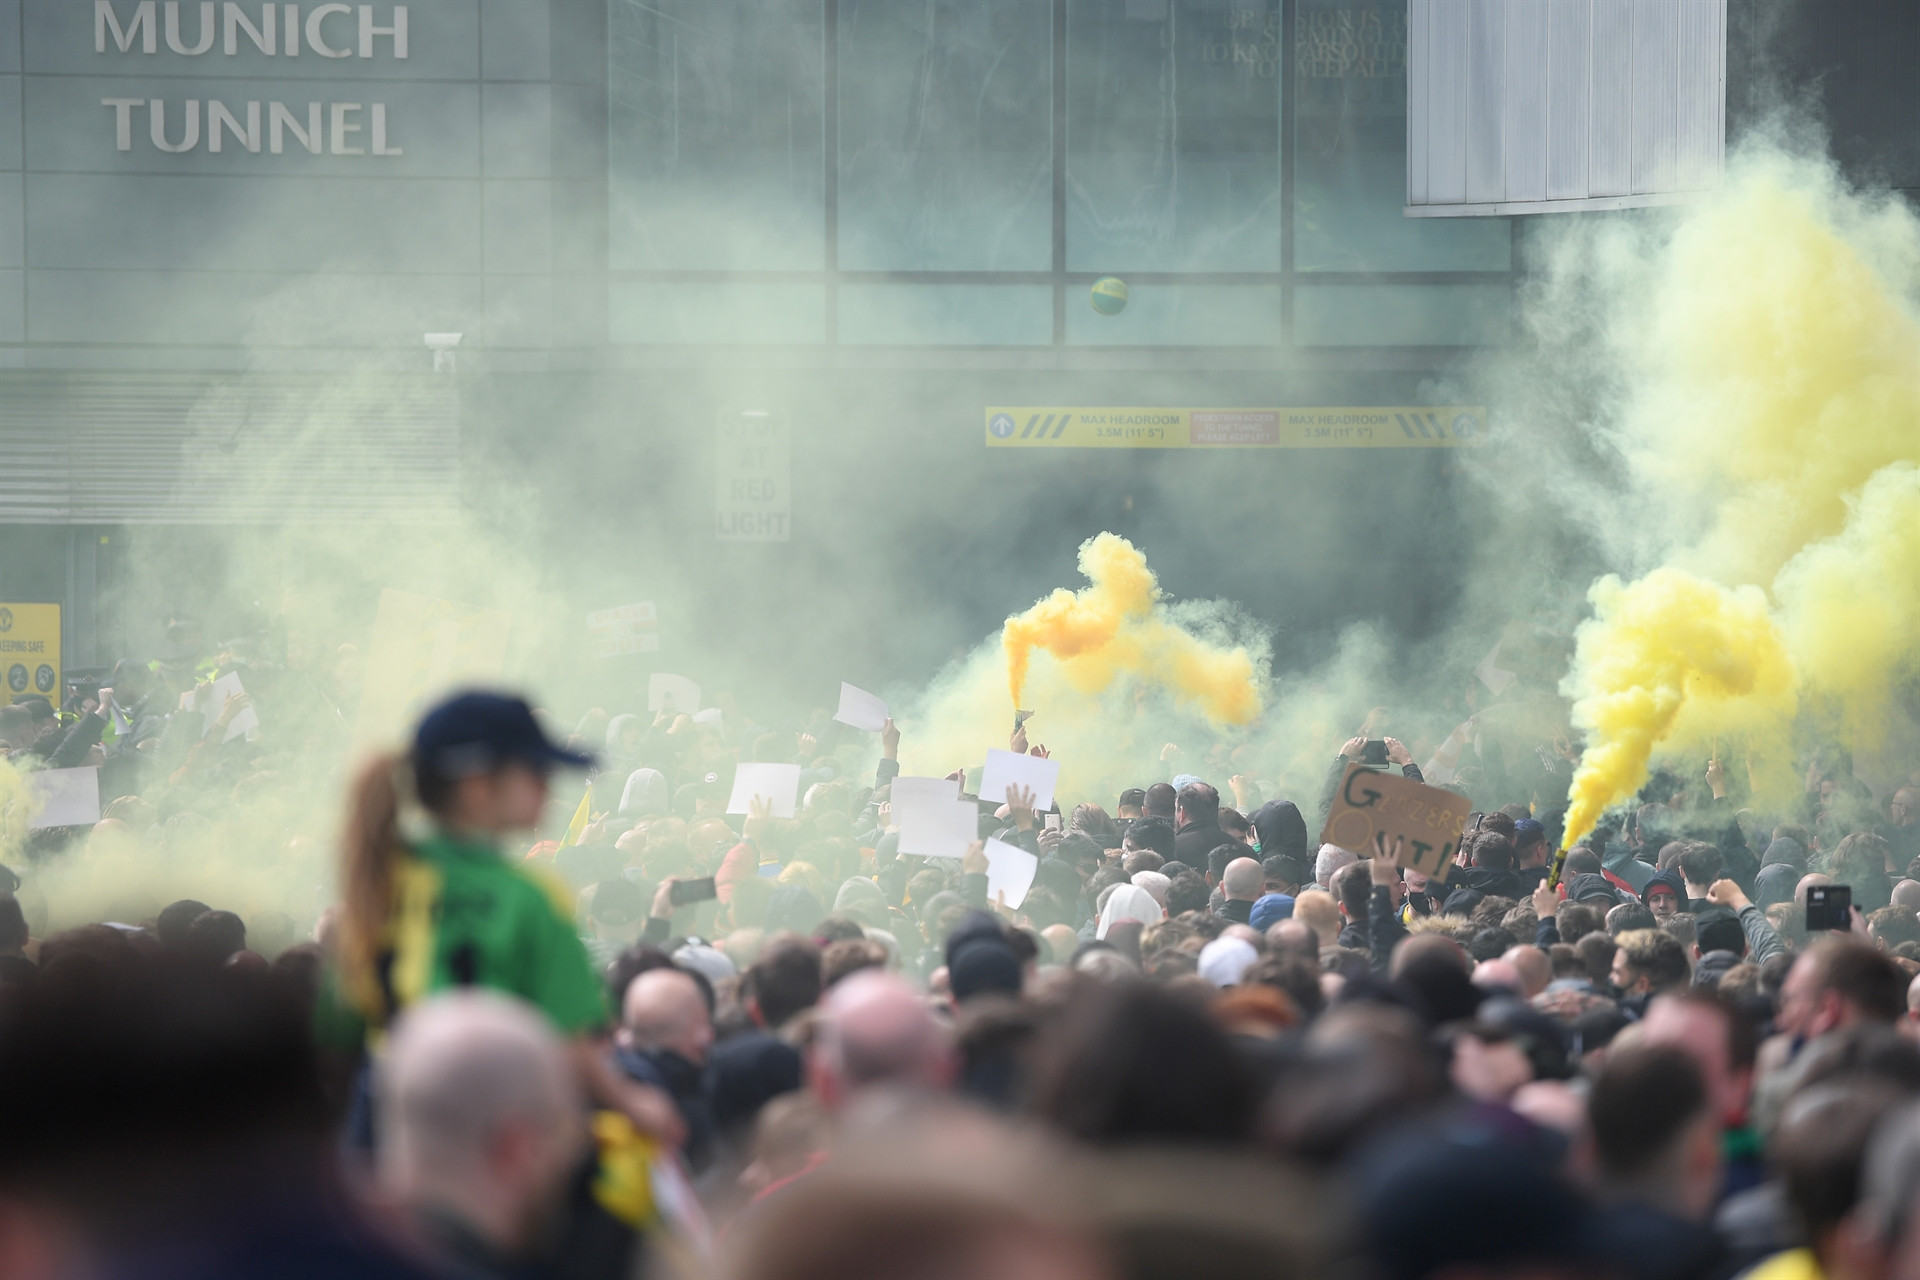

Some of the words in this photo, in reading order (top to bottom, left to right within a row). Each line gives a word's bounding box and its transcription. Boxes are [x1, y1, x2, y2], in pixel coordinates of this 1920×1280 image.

[95, 0, 408, 59] MUNICH
[102, 98, 403, 155] TUNNEL
[1080, 415, 1106, 425] MAX
[1109, 414, 1180, 425] HEADROOM
[1242, 413, 1275, 422] ACCESS
[1288, 414, 1314, 425] MAX
[1317, 414, 1389, 425] HEADROOM
[1096, 427, 1122, 437] 3.5M
[1205, 423, 1216, 432] TO
[1217, 423, 1232, 432] THE
[1233, 423, 1264, 432] TUNNEL
[1303, 427, 1330, 438] 3.5M
[1198, 432, 1228, 441] PLEASE
[1251, 432, 1271, 441] LEFT
[738, 446, 769, 470] AT
[730, 478, 776, 502] RED
[717, 511, 788, 536] LIGHT
[28, 640, 45, 653] SAFE
[1344, 767, 1466, 838] GLAZERS
